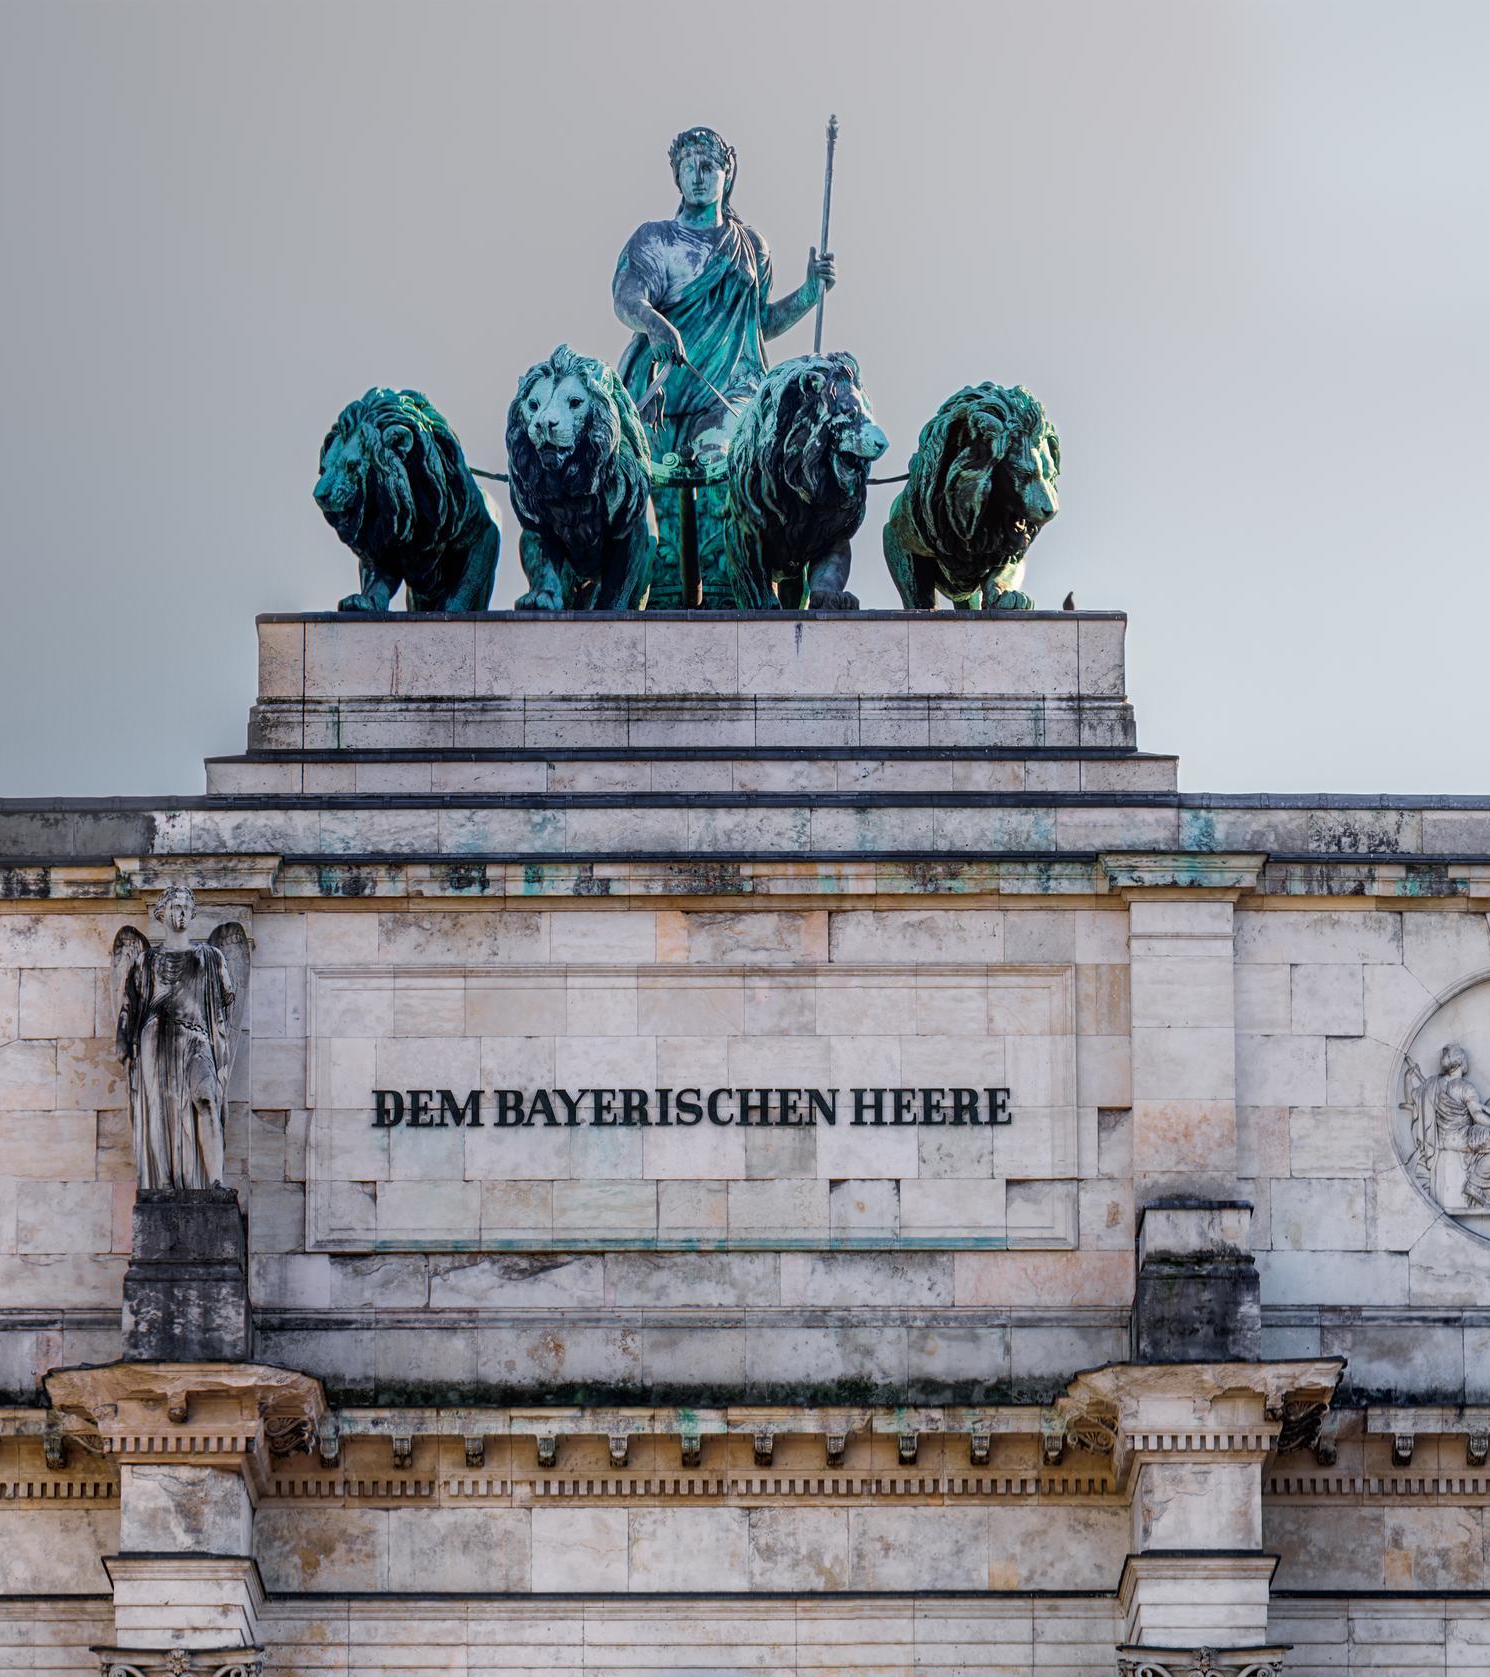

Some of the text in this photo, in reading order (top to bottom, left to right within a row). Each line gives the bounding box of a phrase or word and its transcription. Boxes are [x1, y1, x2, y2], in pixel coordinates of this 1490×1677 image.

[371, 1087, 1012, 1128] DEM BAYERISCHEN HEERE
